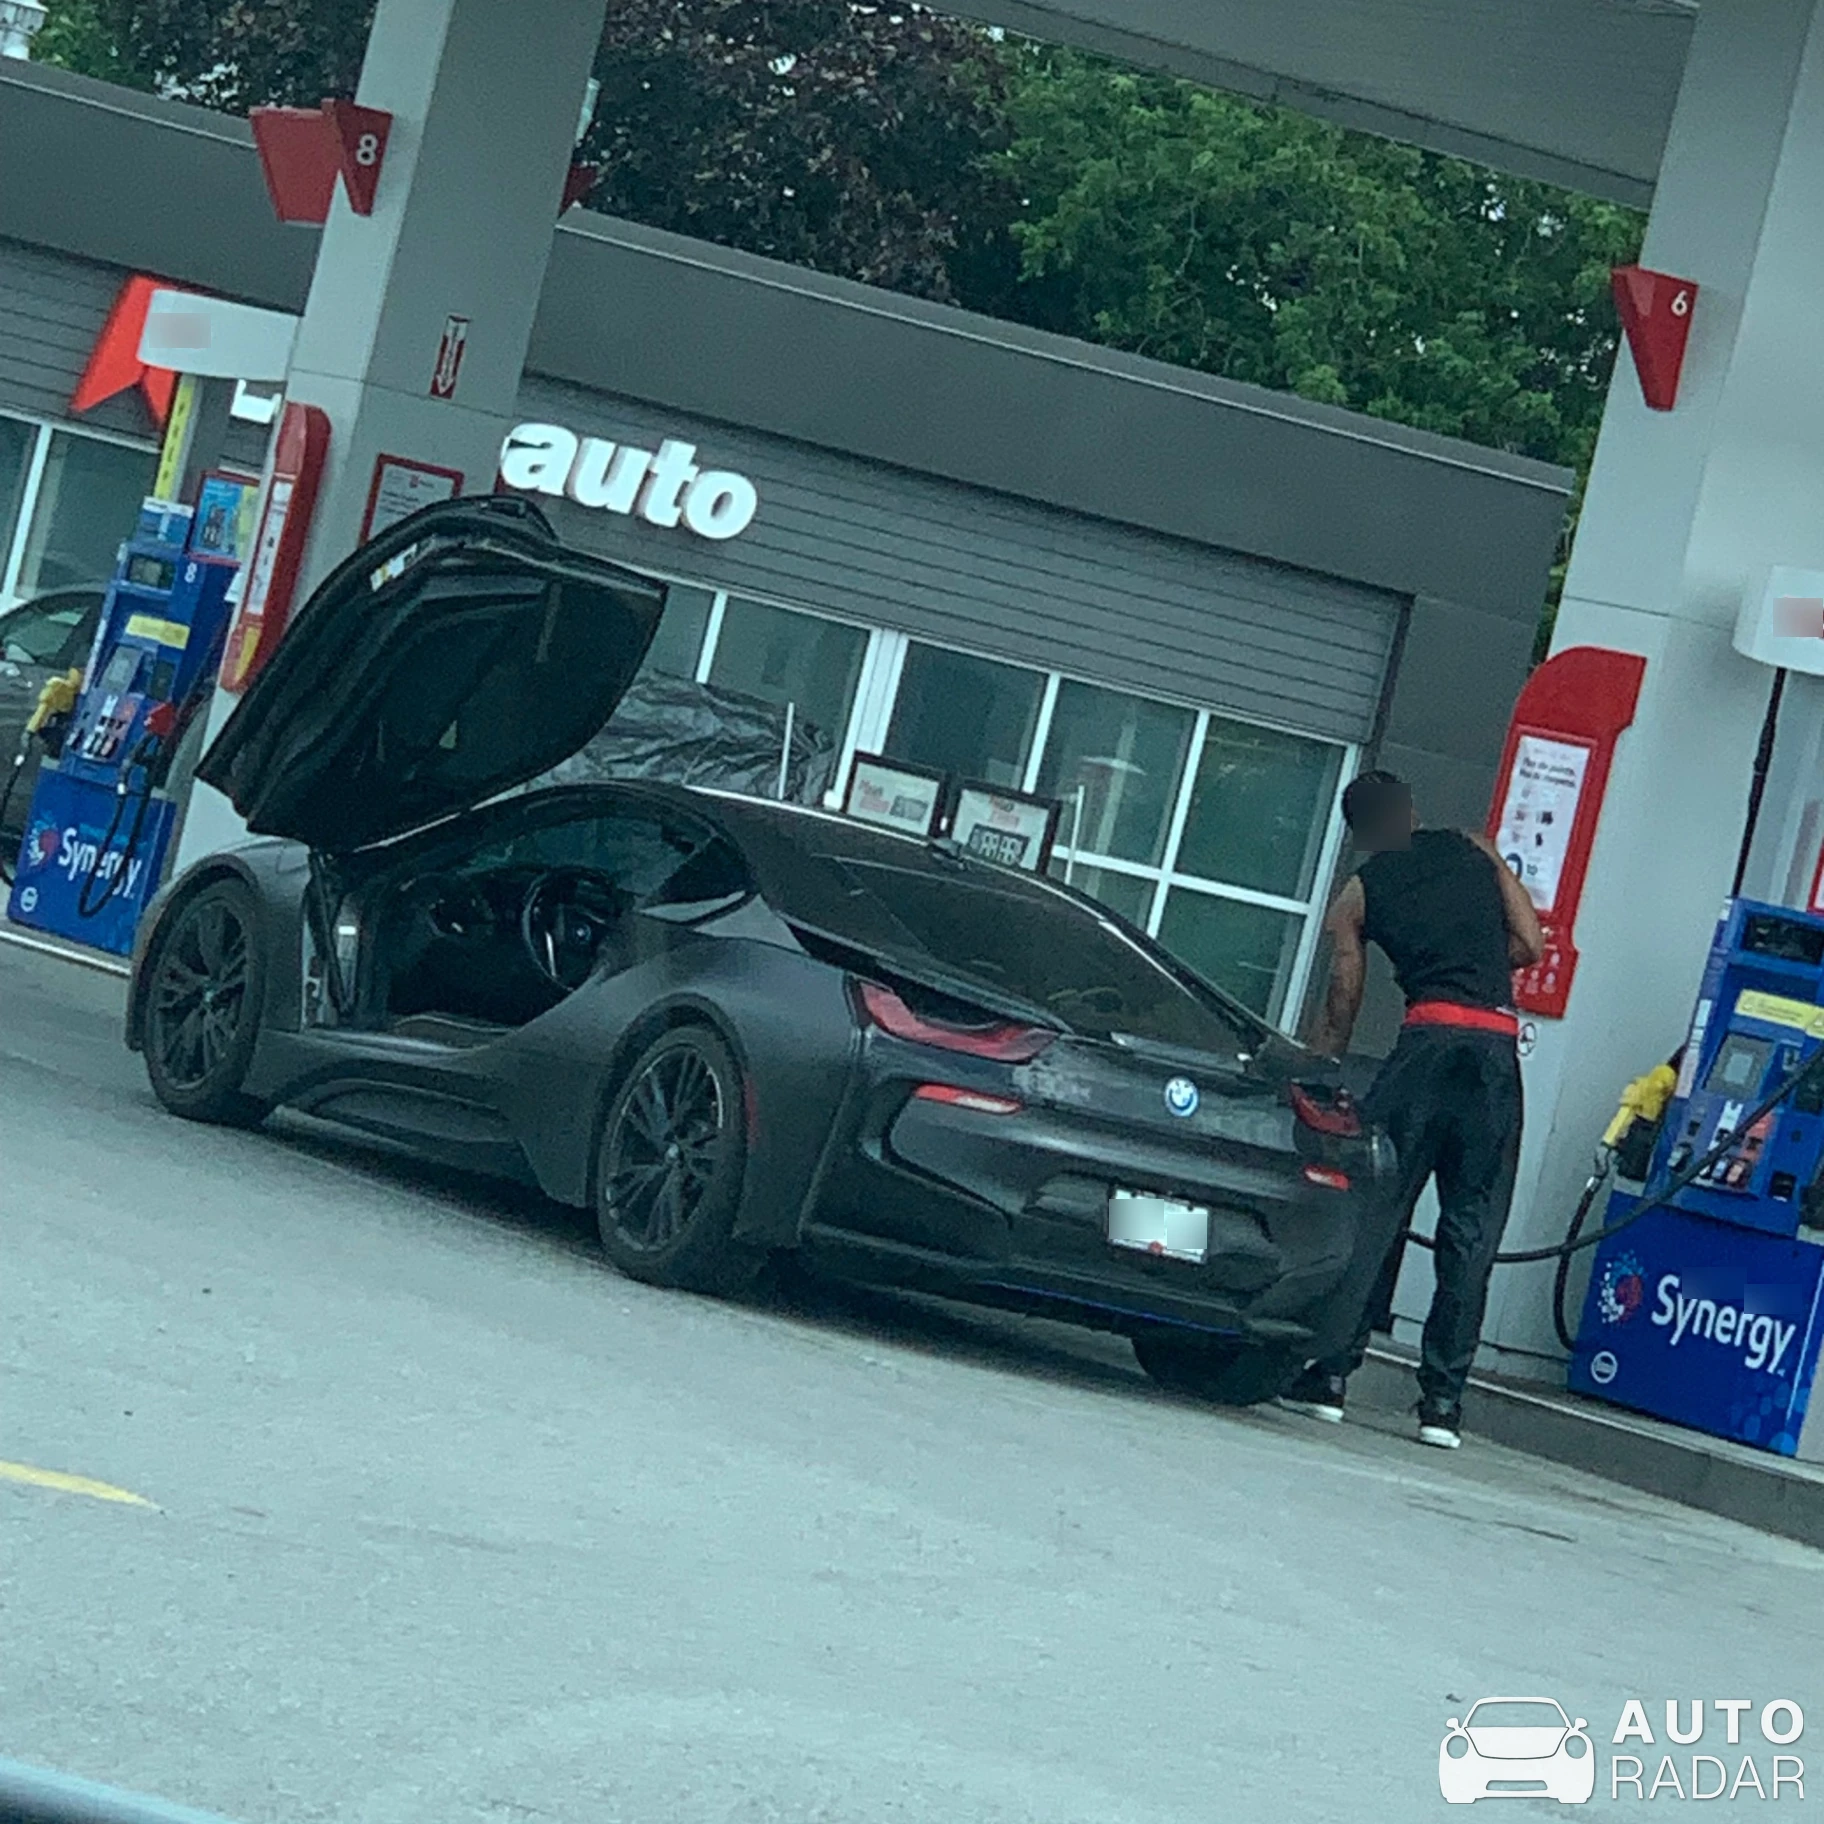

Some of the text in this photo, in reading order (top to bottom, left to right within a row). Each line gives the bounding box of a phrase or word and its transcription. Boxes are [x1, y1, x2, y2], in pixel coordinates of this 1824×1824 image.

[356, 133, 378, 166] 8
[1671, 290, 1687, 316] 6
[501, 422, 757, 539] auto
[184, 562, 198, 583] 8
[1651, 1273, 1796, 1375] Synergy
